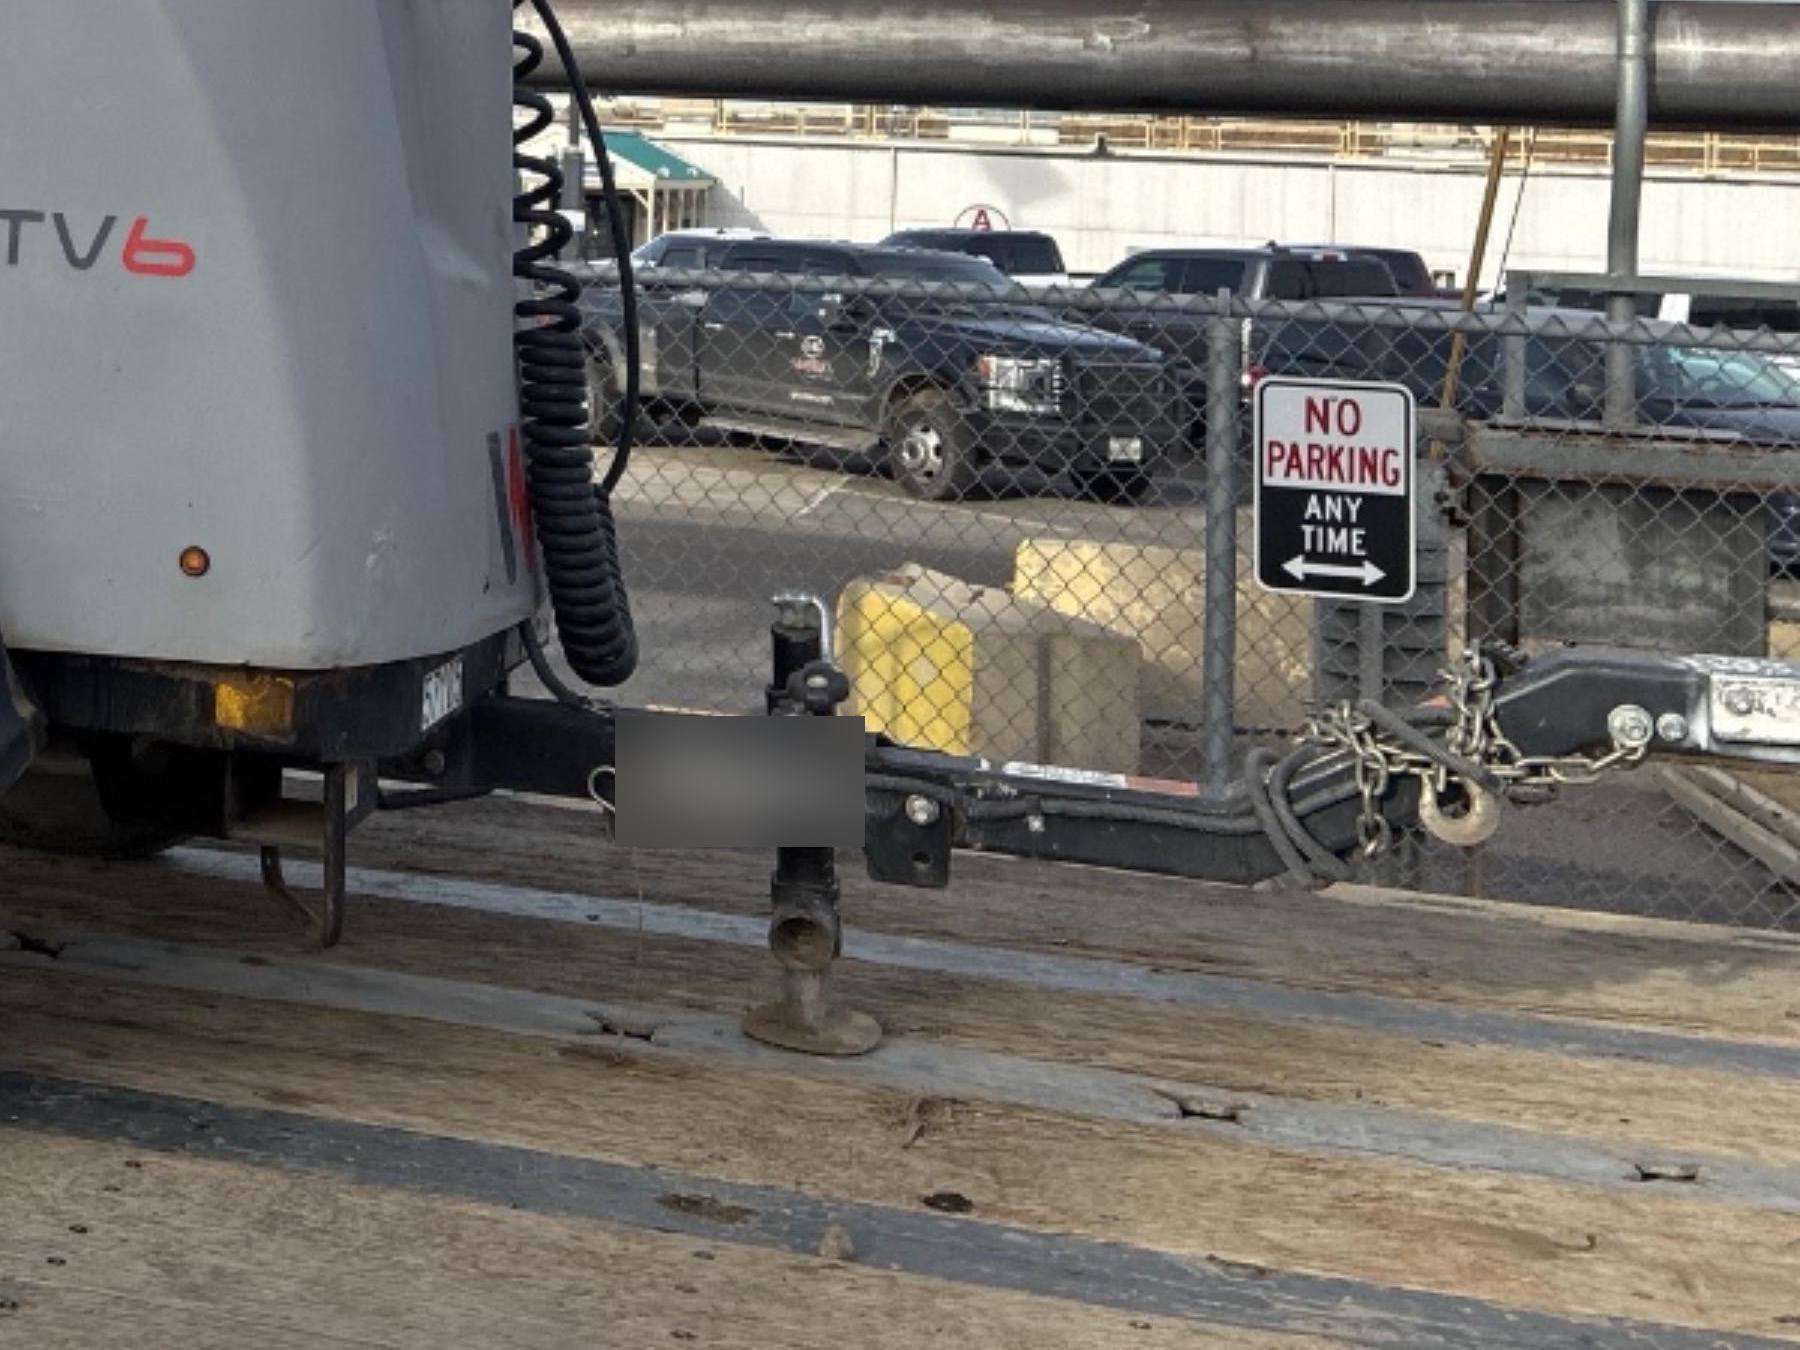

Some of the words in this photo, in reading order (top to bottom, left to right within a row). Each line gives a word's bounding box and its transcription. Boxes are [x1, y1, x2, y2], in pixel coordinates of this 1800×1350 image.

[1304, 396, 1361, 436] NO
[1267, 441, 1400, 487] PARKING
[1305, 494, 1363, 523] ANY
[1301, 525, 1367, 556] TIME
